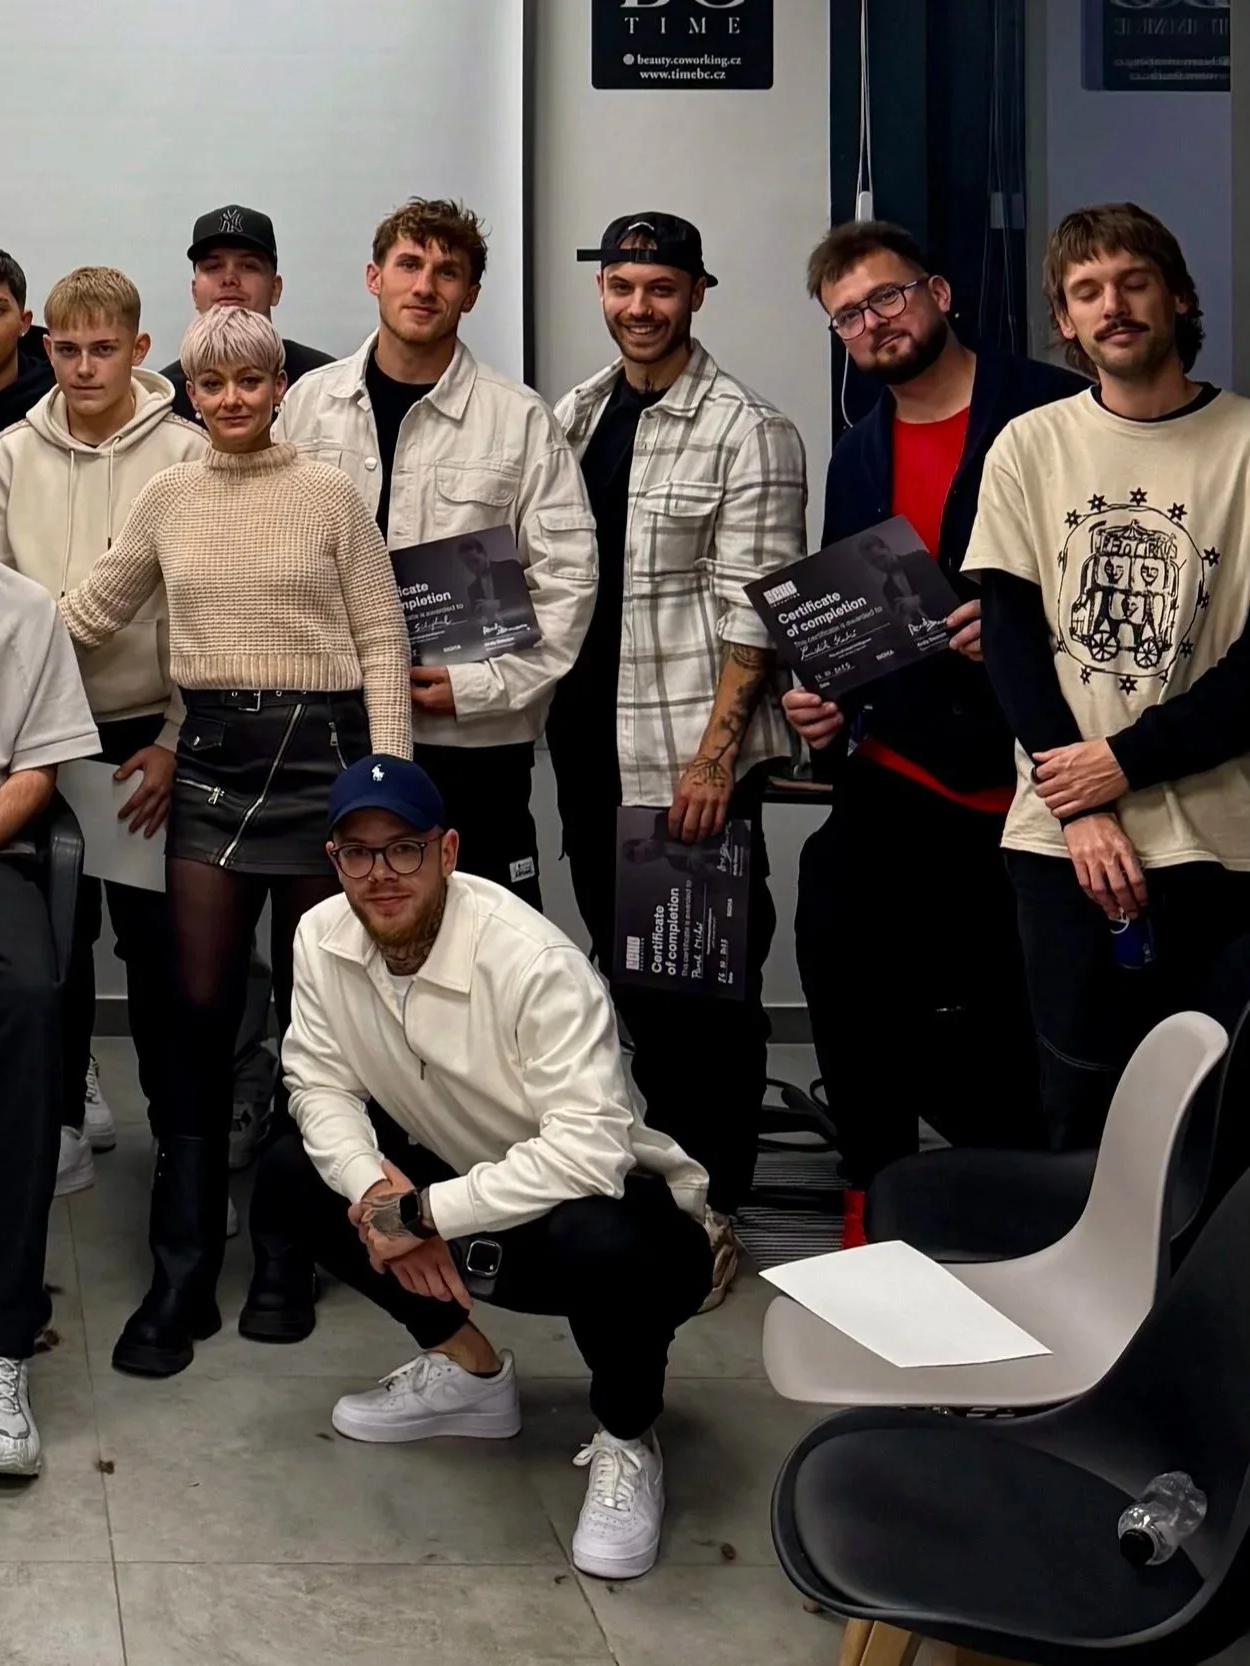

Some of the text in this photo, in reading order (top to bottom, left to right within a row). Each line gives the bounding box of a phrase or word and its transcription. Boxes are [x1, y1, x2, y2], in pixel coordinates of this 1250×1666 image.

[624, 17, 740, 34] TIME
[637, 54, 742, 67] beauty.coworking.cz
[639, 68, 726, 80] www.timebc.cz
[401, 591, 452, 611] mpletion
[778, 591, 841, 624] Certificate
[786, 623, 800, 638] of
[800, 596, 867, 632] completion
[651, 905, 665, 973] Certificate
[666, 888, 680, 976] of completion
